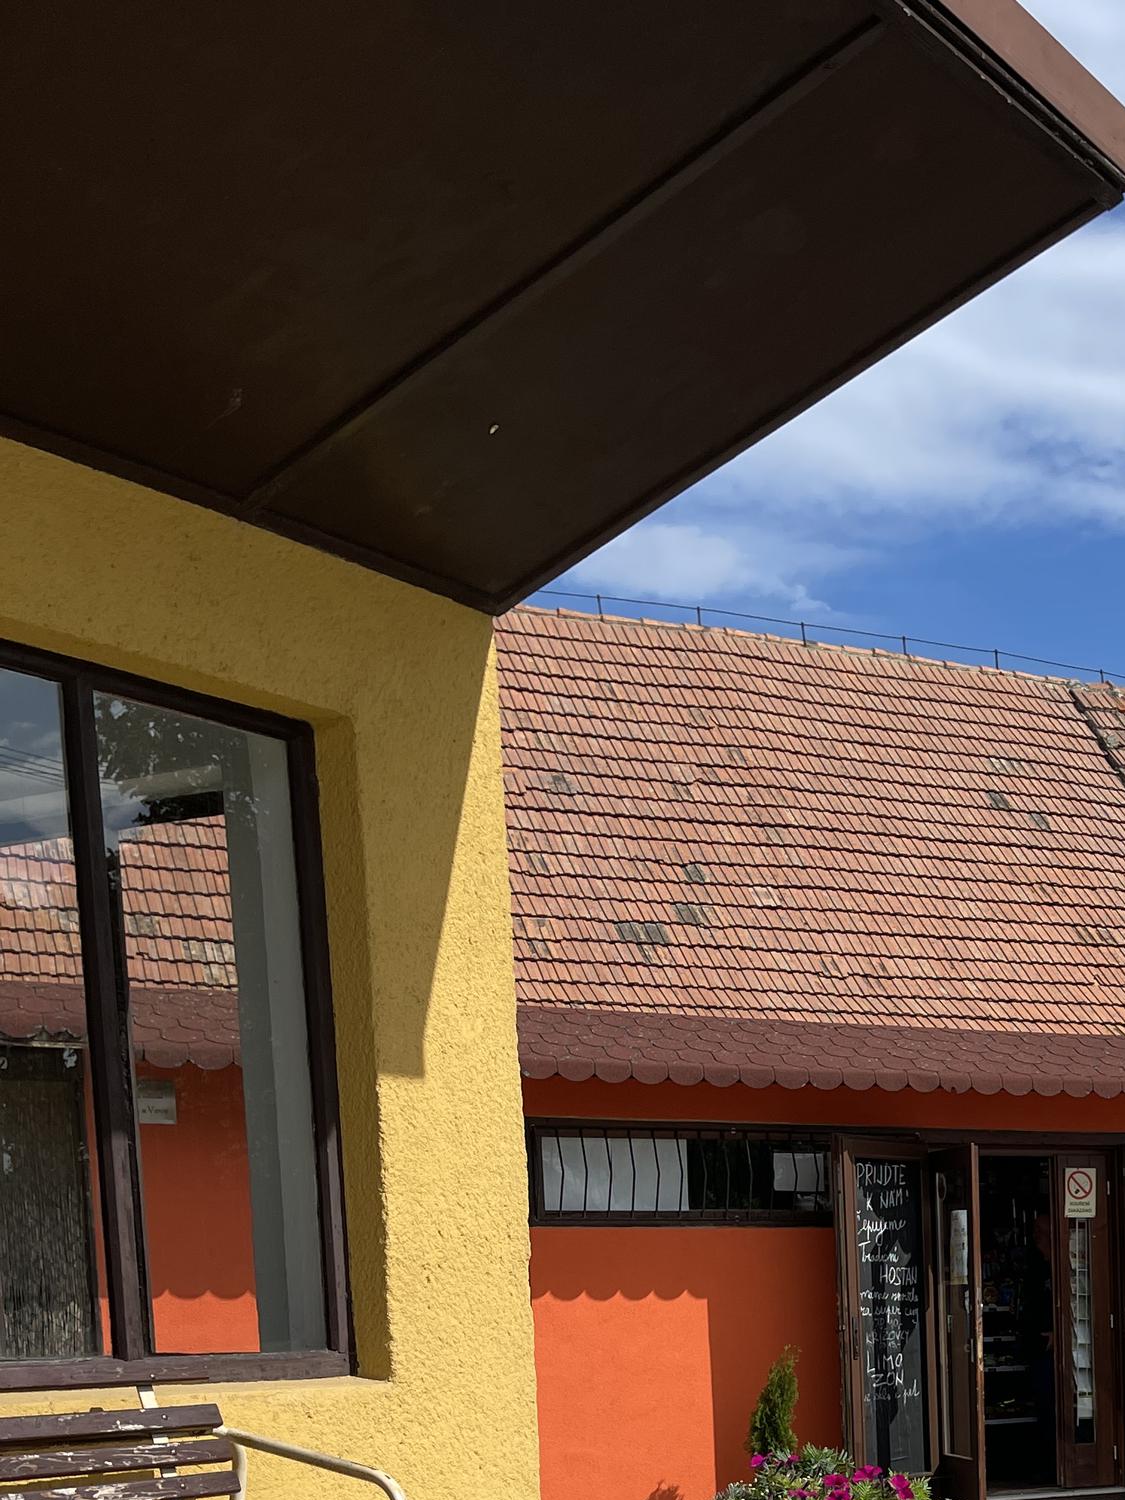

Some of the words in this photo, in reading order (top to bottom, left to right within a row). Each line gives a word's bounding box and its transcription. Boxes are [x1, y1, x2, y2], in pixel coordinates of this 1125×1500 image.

[866, 1191, 874, 1211] K
[879, 1263, 918, 1286] HOSTAN
[866, 1350, 903, 1374] LIMO
[871, 1369, 904, 1388] ZON
